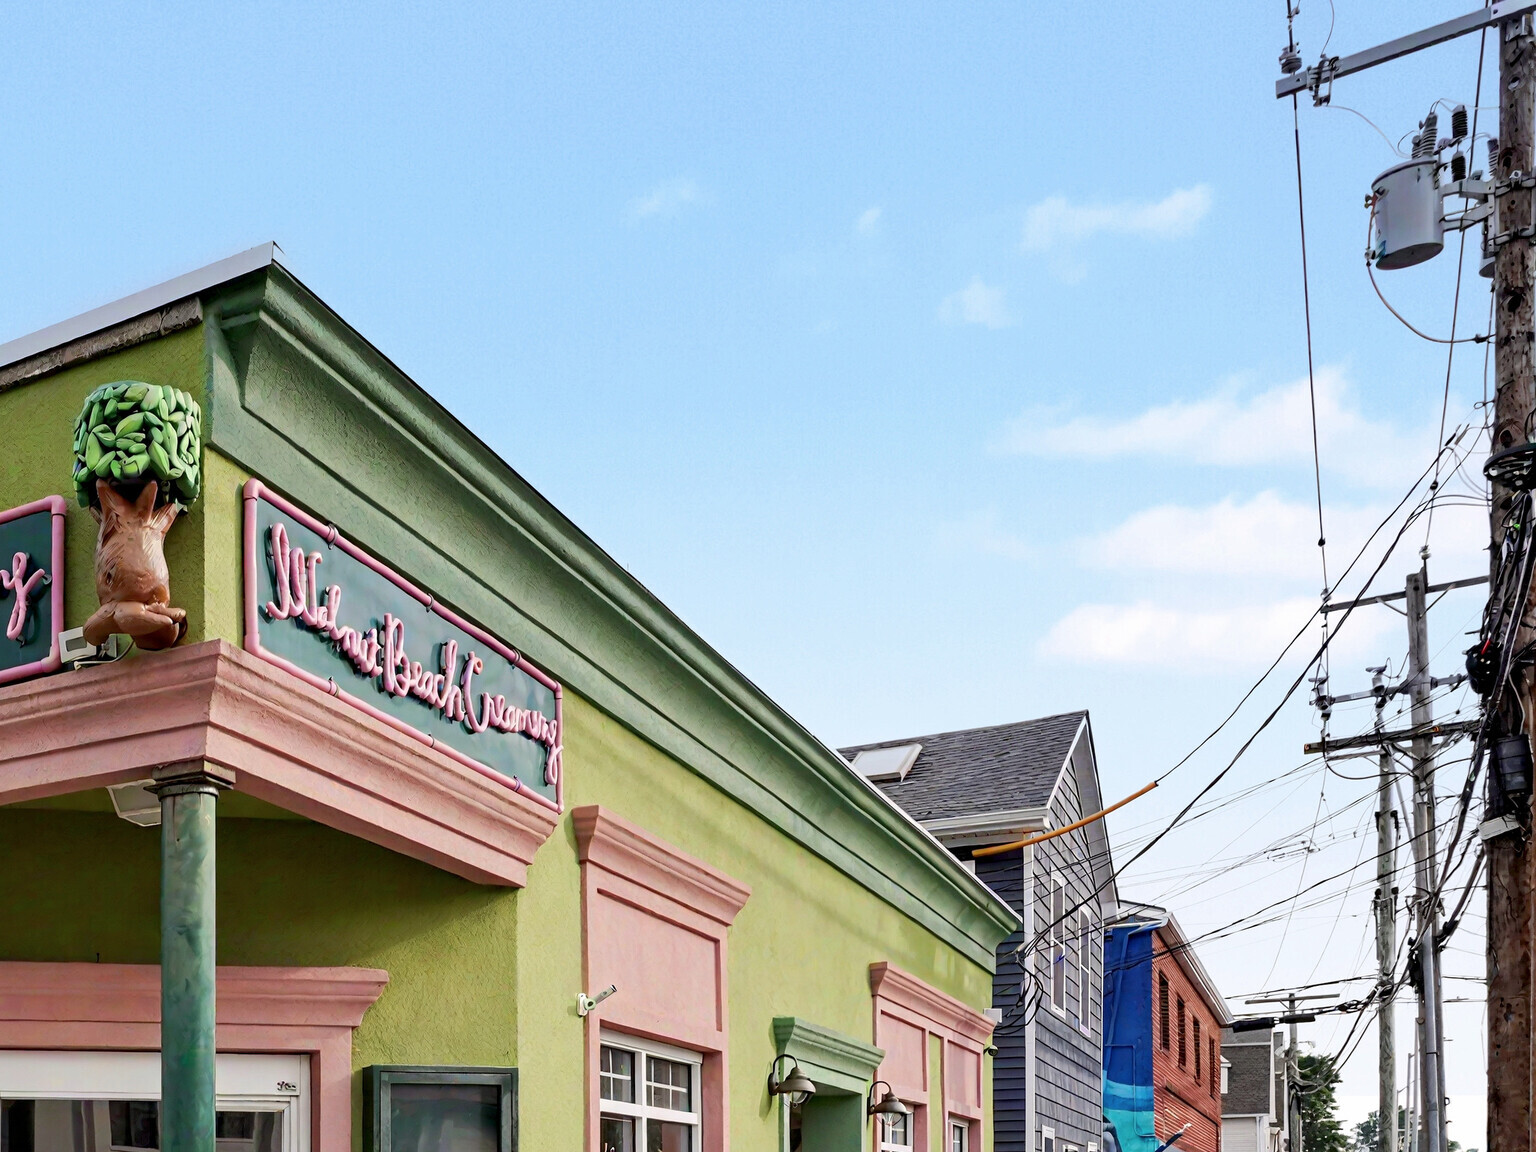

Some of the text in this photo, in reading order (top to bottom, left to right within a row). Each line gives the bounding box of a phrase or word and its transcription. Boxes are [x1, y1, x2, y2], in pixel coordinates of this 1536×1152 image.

[266, 522, 564, 785] Walnut Beach Creamery
